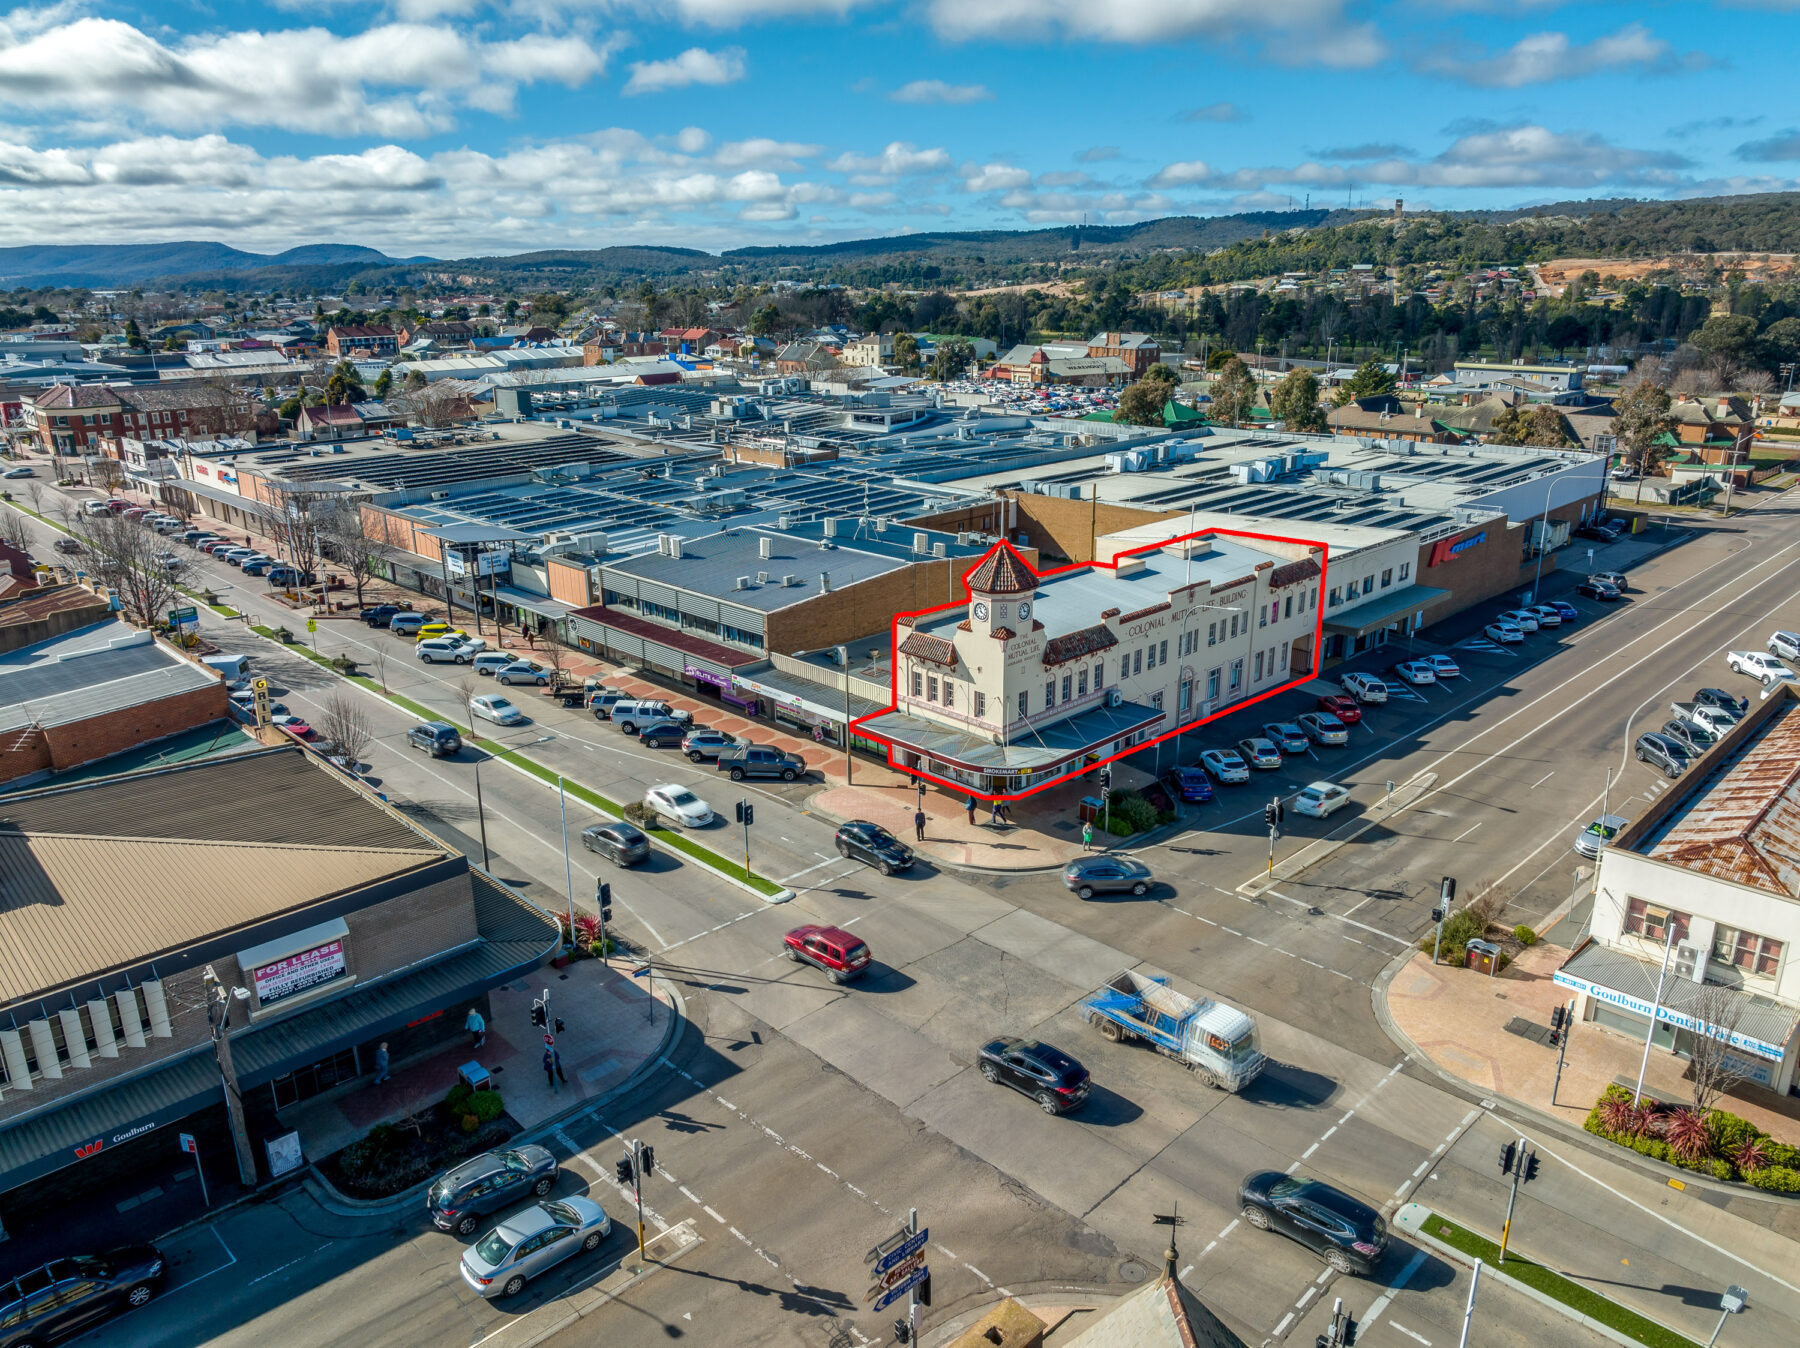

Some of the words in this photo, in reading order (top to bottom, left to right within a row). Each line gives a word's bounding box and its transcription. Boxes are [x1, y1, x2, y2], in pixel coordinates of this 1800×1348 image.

[1428, 531, 1487, 568] Kmart
[1128, 616, 1165, 637] COLONIAL
[1202, 600, 1215, 612] LIFE
[1220, 589, 1247, 605] BUILDING
[1008, 649, 1028, 660] MUTUAL
[1031, 644, 1040, 653] LIFE
[1010, 638, 1037, 651] COLONIAL
[983, 767, 1018, 775] SMOKEMART
[257, 963, 288, 977] FOR
[292, 943, 338, 965] LEASE
[264, 974, 284, 984] OFFICE
[300, 962, 318, 970] OTHER
[269, 982, 288, 992] FULLY
[291, 966, 334, 984] REFURBISHED
[295, 982, 314, 991] LOCAL
[1590, 985, 1652, 1014] Goulburn
[1656, 1007, 1702, 1032] Dental
[1706, 1022, 1739, 1044] Care
[113, 1122, 155, 1143] Goulburn
[905, 1232, 925, 1249] CENTRE
[888, 1255, 900, 1267] AND
[902, 1238, 925, 1257] LIBRARY
[901, 1257, 924, 1276] GALLERY
